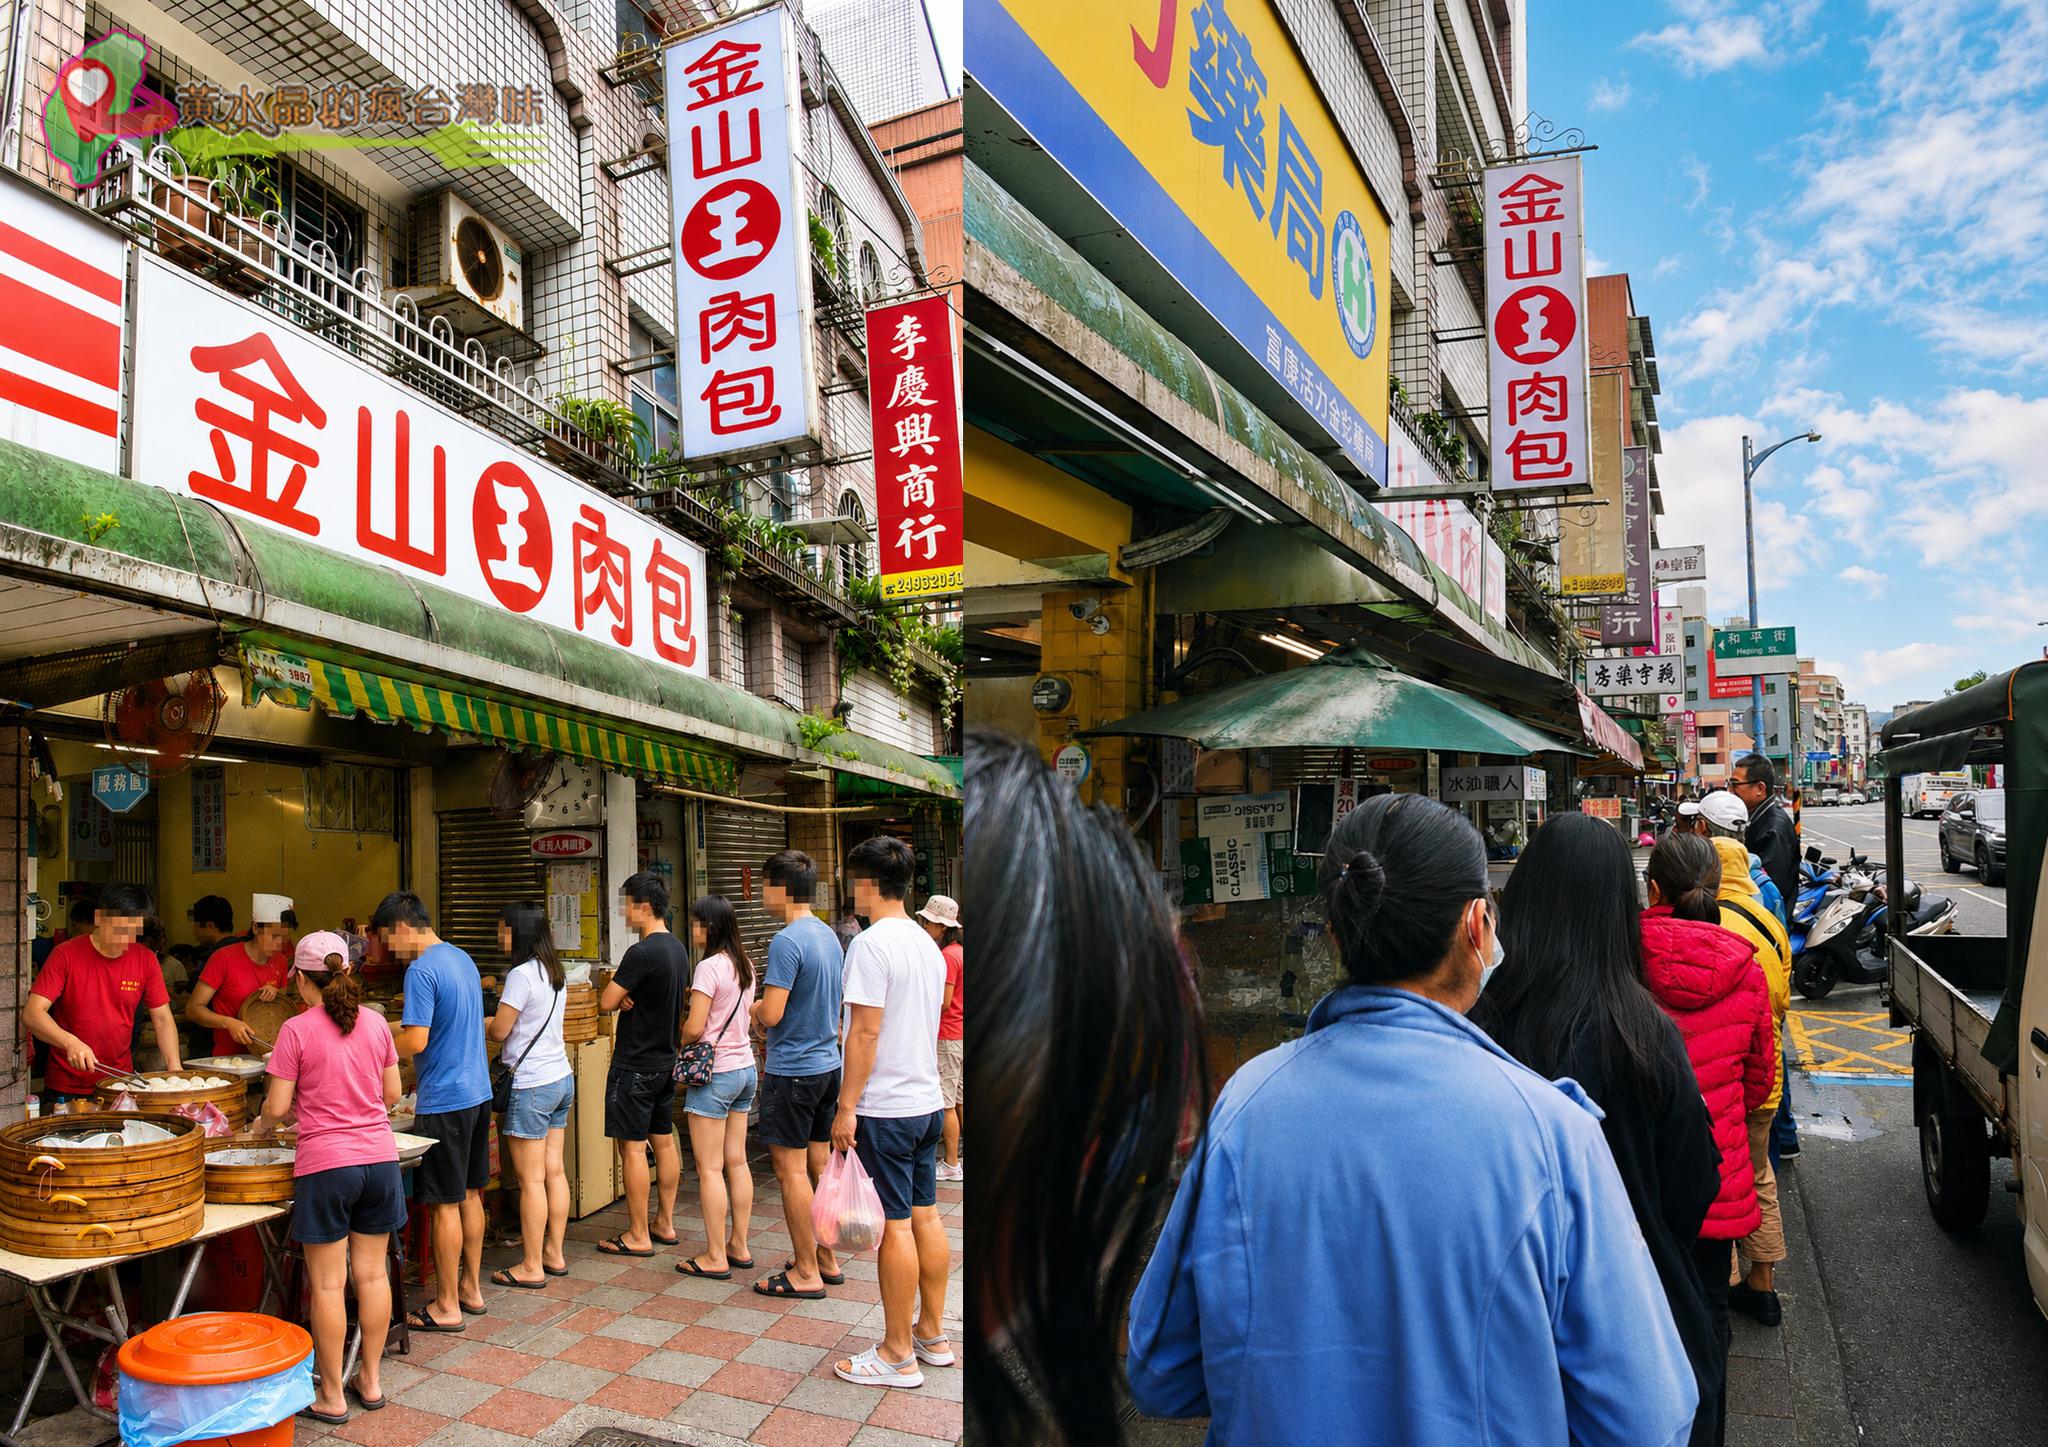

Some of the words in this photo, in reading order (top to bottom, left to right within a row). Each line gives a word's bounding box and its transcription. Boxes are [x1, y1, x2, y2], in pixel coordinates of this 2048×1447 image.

[681, 39, 782, 436] 金山王肉包
[1494, 173, 1577, 482] 金山王肉包
[188, 331, 697, 668] 金山王肉包
[886, 314, 946, 560] 李慶興商行
[1728, 630, 1786, 645] 和平街
[1227, 838, 1241, 897] CLASSIC
